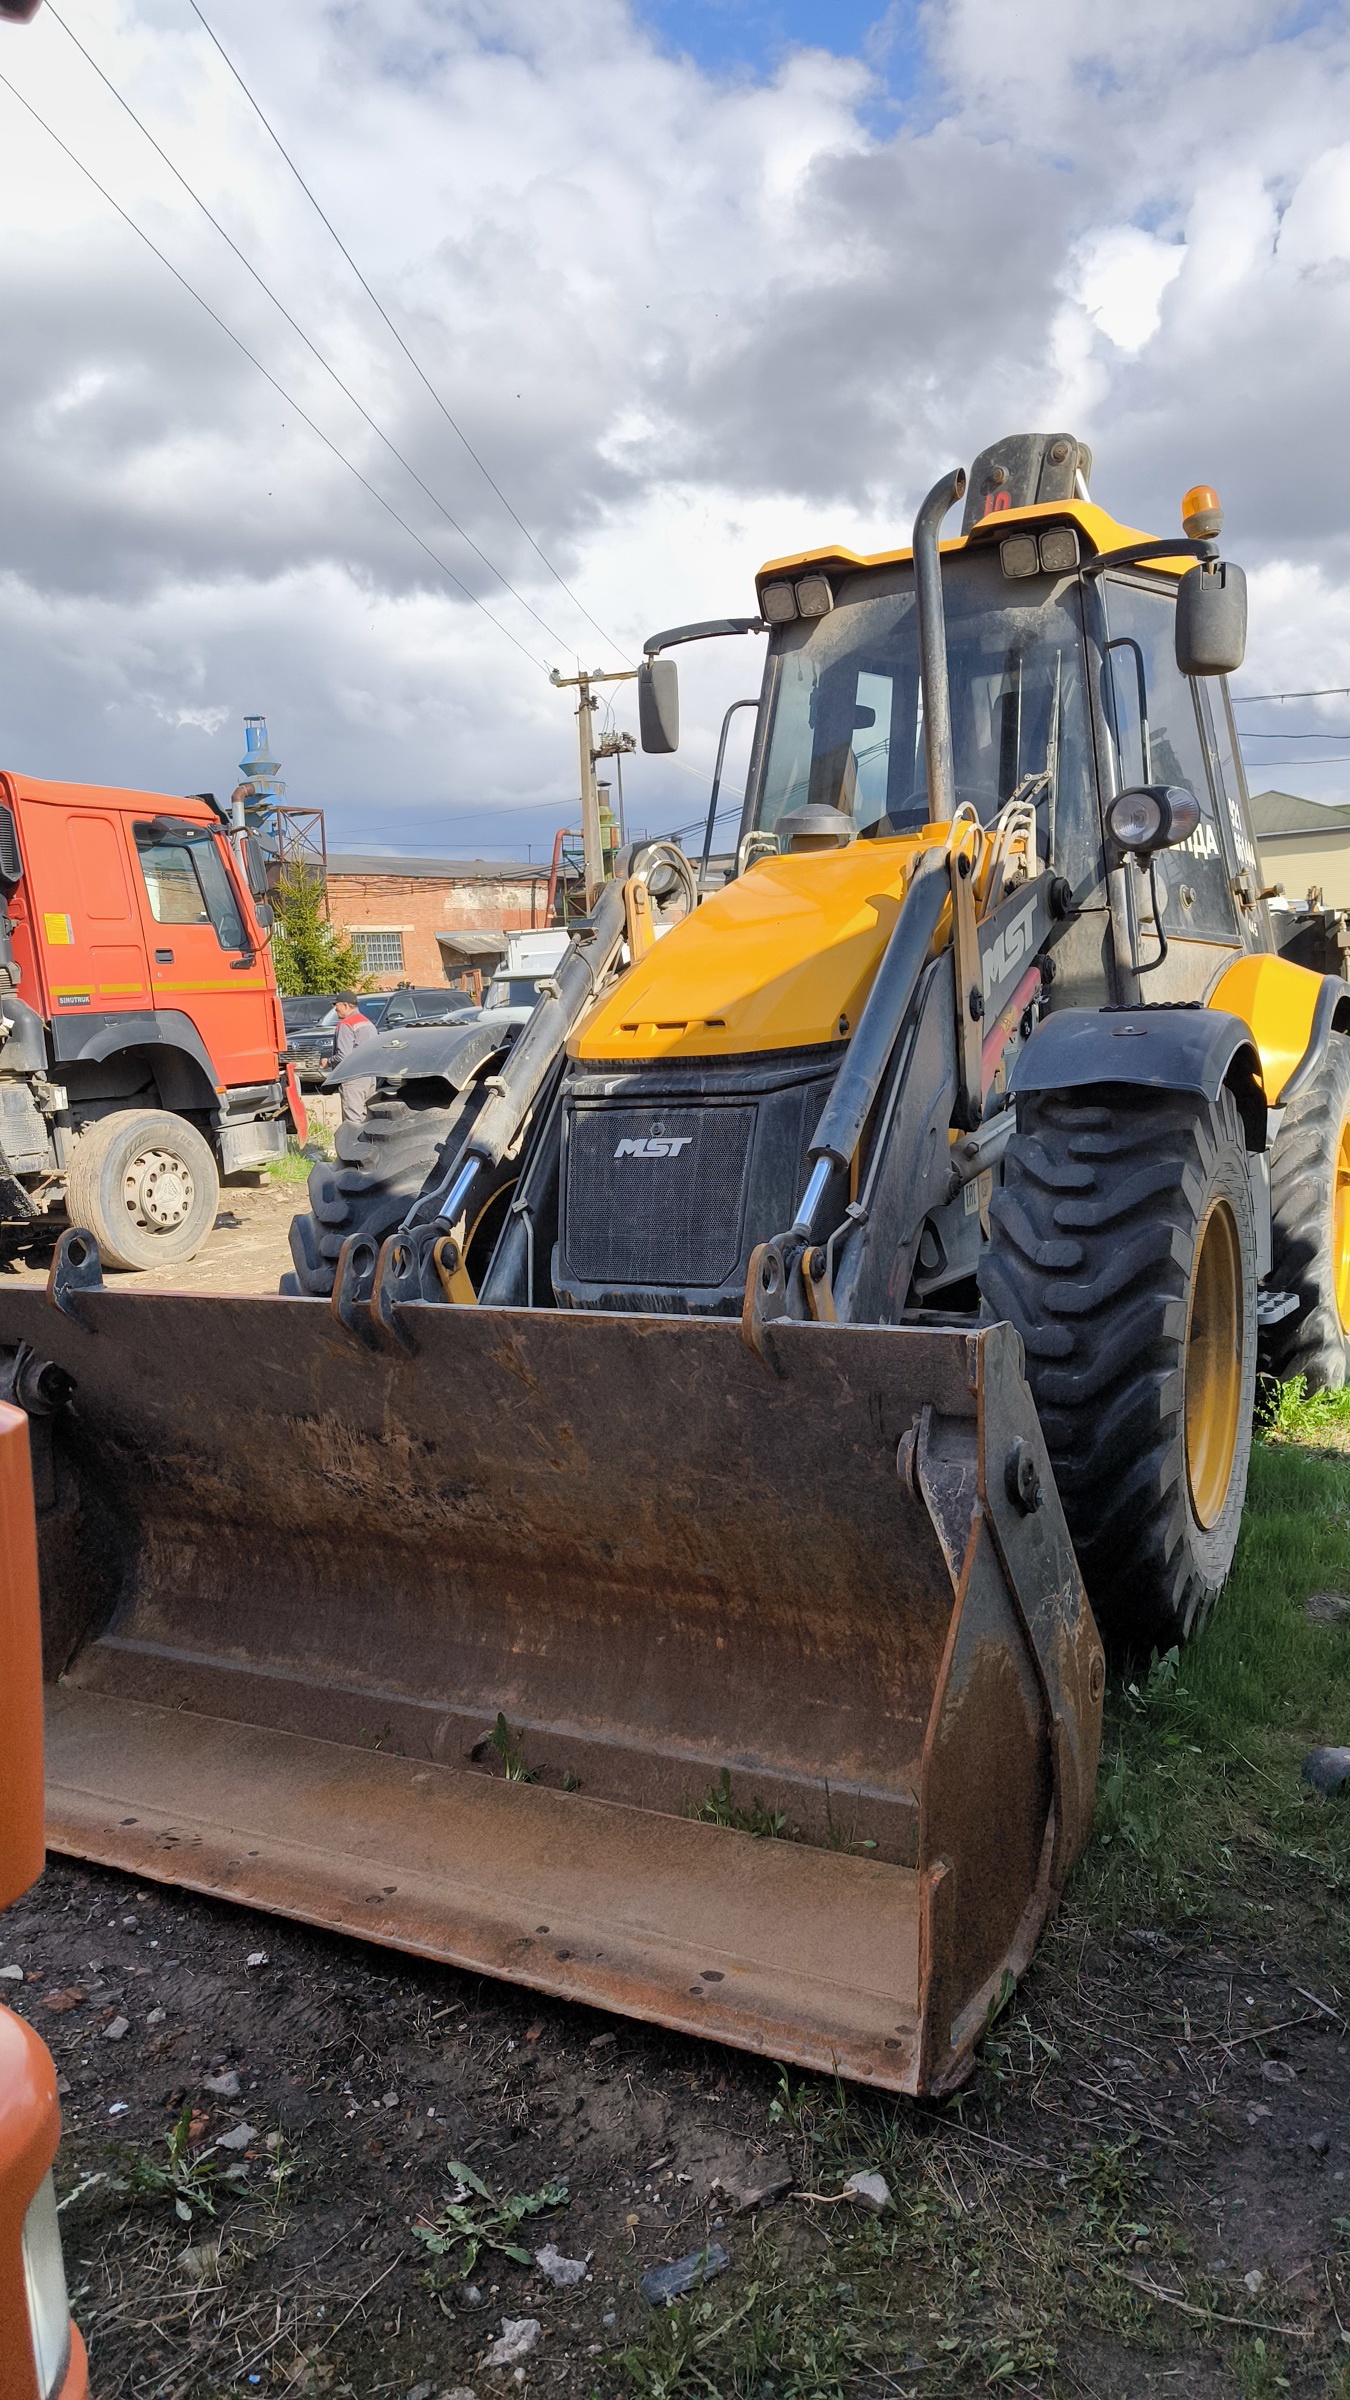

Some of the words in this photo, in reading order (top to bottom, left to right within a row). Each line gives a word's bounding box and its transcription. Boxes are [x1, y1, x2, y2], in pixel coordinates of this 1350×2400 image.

[982, 894, 1038, 1002] MST
[59, 995, 91, 1004] SINOTRUK
[613, 1137, 693, 1158] MST
